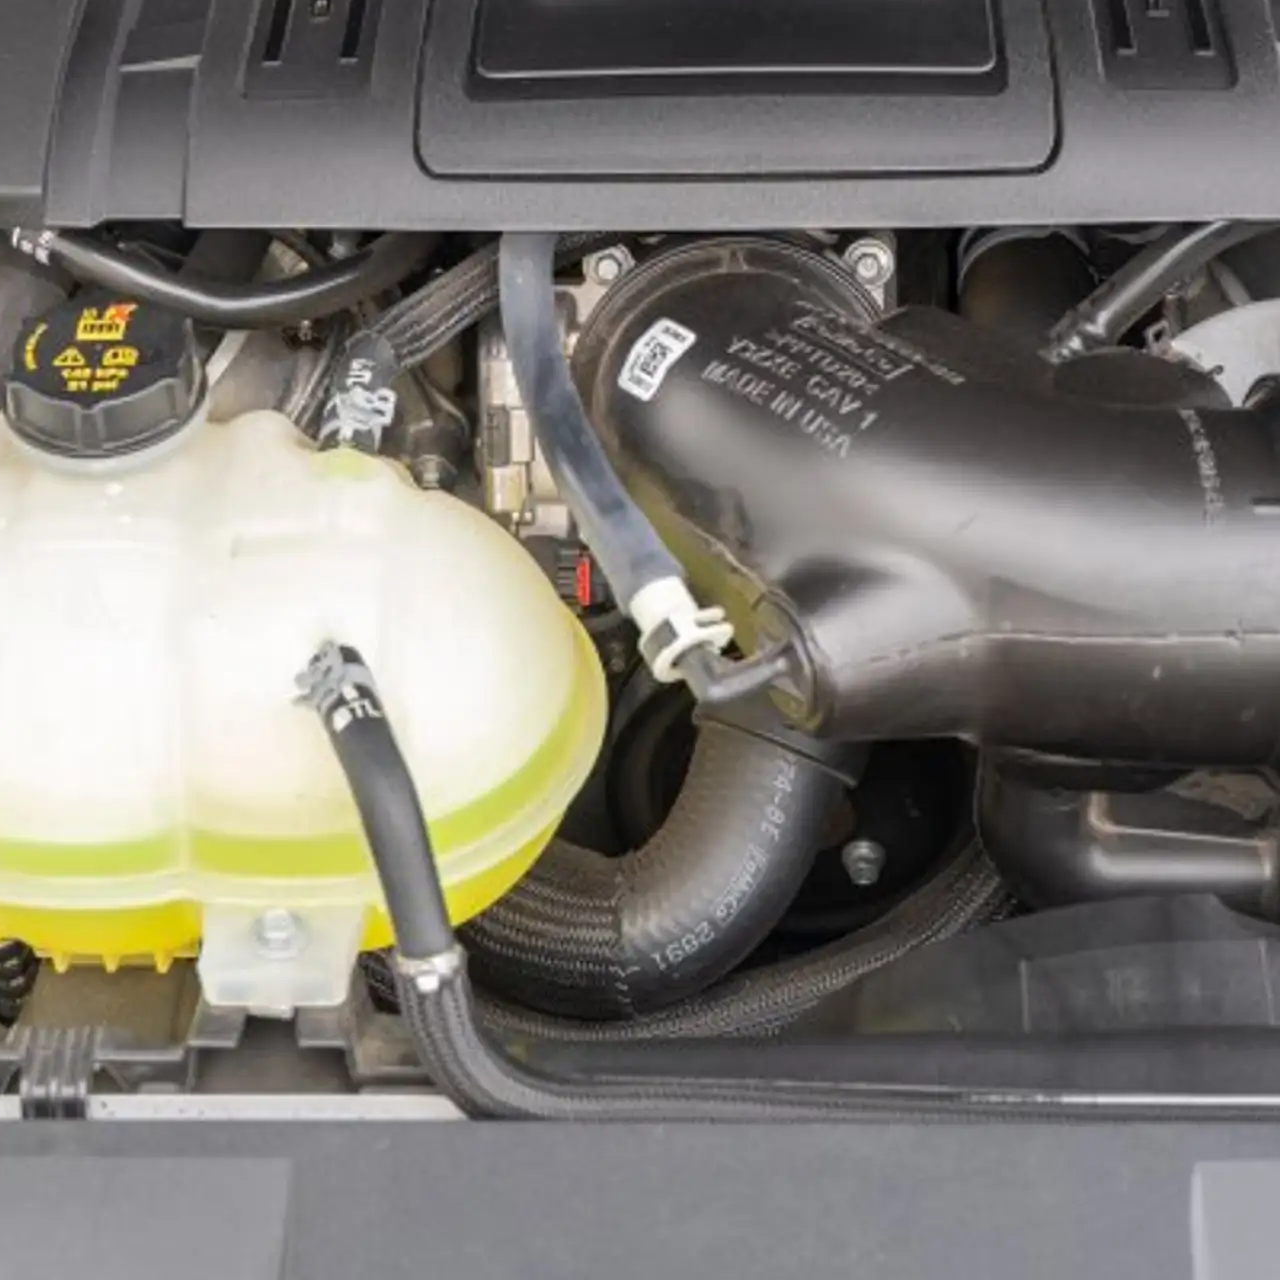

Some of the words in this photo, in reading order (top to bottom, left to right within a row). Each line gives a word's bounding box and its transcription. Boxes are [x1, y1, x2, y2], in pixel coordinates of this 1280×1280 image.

[700, 360, 774, 406] MADE
[769, 390, 802, 421] IN
[798, 409, 852, 458] USA
